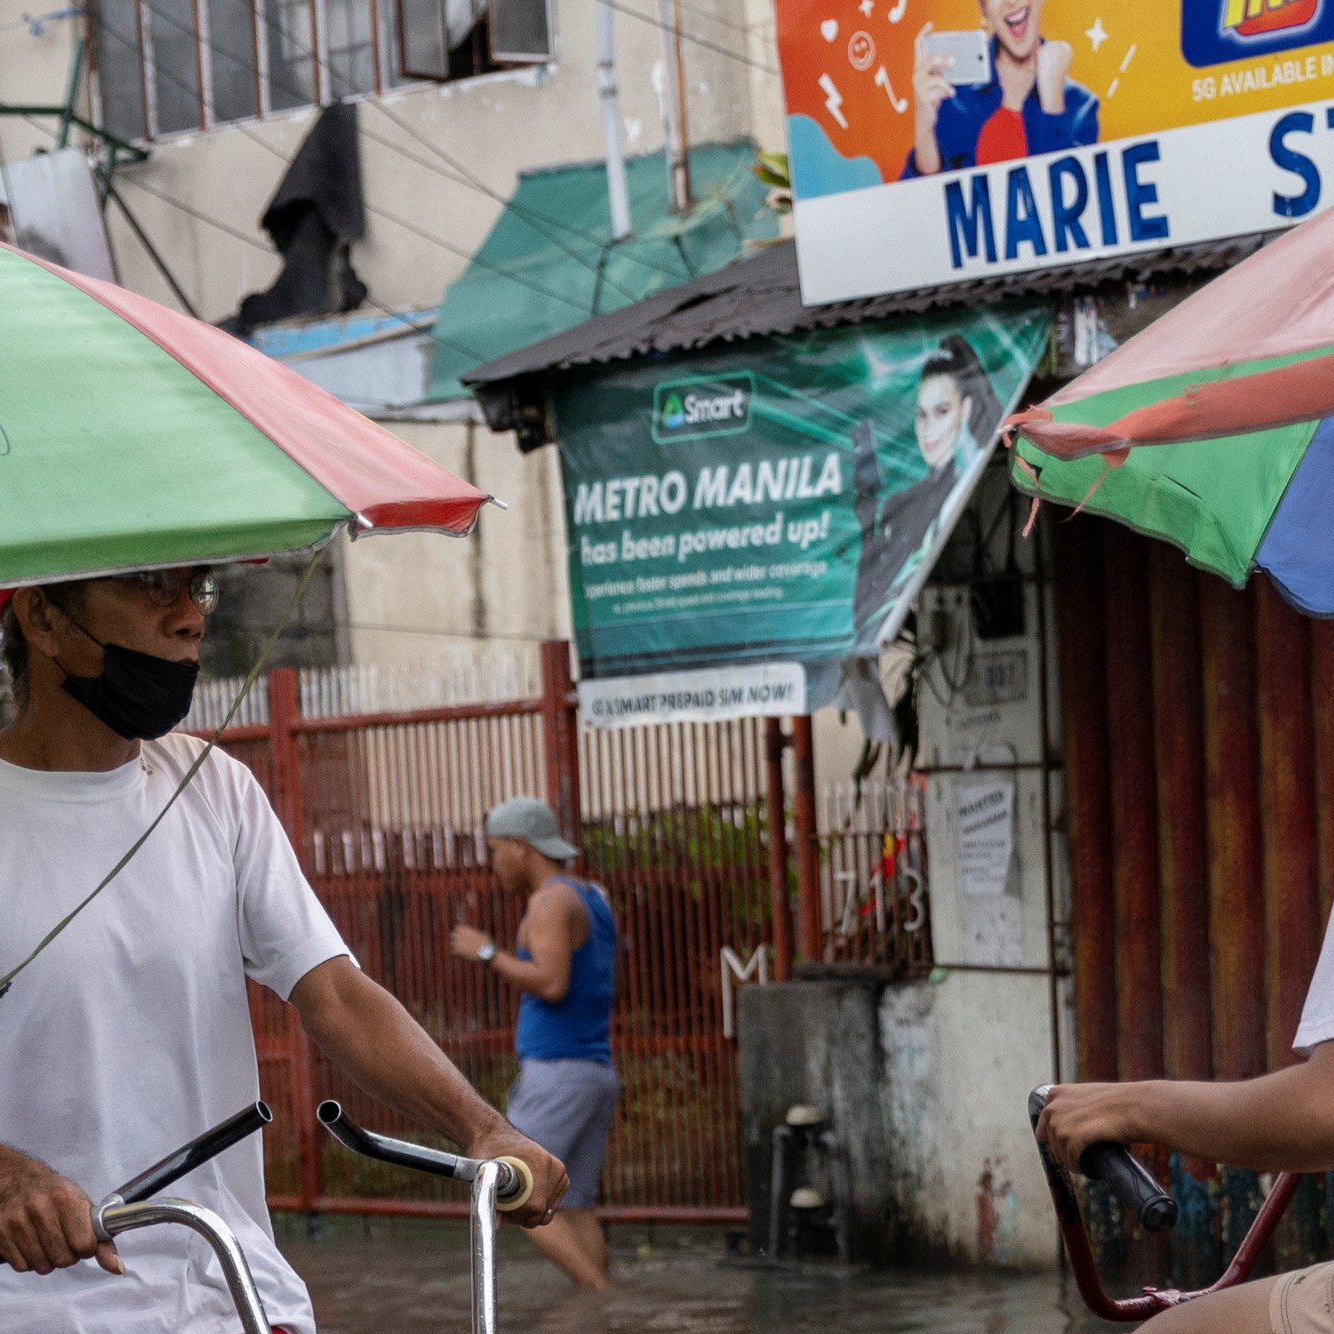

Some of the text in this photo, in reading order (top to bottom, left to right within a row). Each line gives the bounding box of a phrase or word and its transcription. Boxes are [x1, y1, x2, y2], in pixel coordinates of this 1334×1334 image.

[1192, 74, 1216, 101] 5G
[1219, 57, 1316, 96] AVAILABLE
[945, 140, 1171, 270] MARIE
[684, 387, 745, 421] Smart
[573, 452, 843, 525] METRO MANILA
[581, 511, 830, 567] has been powered up!
[734, 565, 766, 582] wider
[768, 560, 828, 579] coverage
[660, 689, 714, 710] PREPAID
[717, 686, 744, 706] SIM
[747, 683, 794, 702] NOW!
